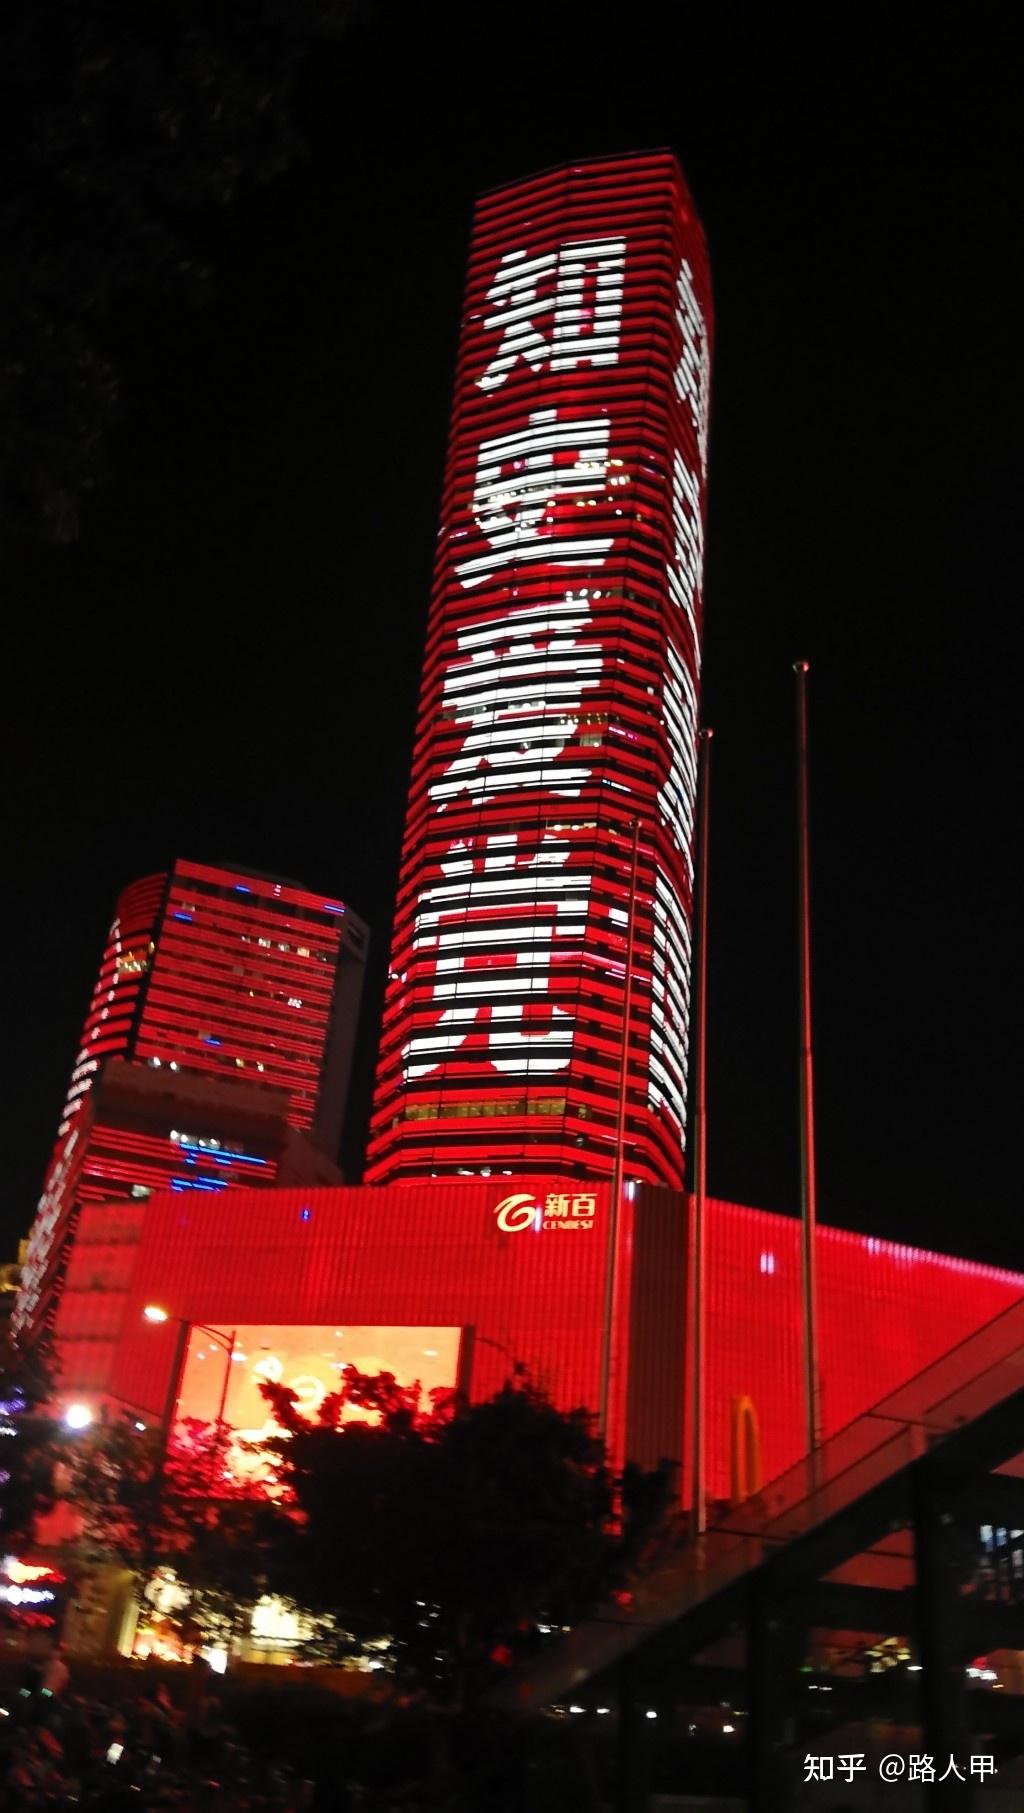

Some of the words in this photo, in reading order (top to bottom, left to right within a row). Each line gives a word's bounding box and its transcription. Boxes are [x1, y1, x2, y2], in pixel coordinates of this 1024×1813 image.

[401, 235, 627, 1082] 知史爱党
[544, 1193, 598, 1217] 新百
